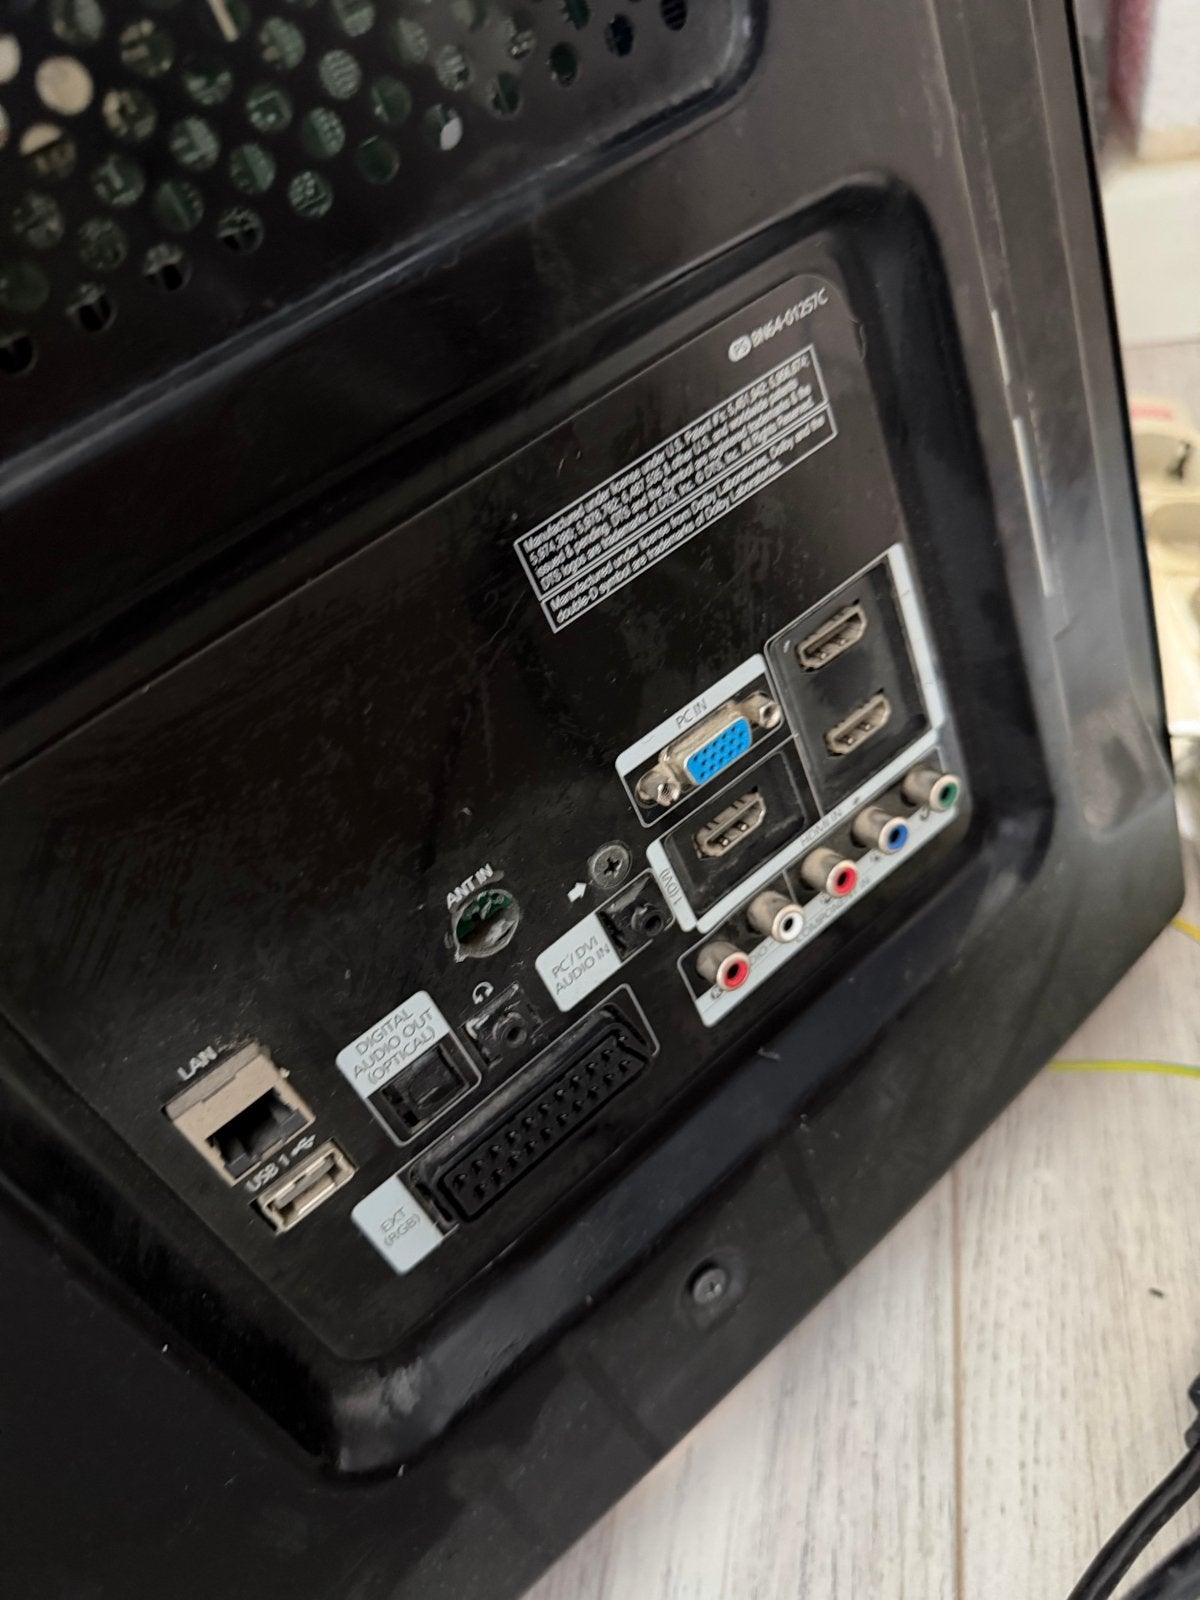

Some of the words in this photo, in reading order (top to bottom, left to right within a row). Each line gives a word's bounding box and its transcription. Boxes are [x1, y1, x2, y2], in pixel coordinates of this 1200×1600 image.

[550, 561, 612, 610] Manufactured
[612, 544, 638, 568] under
[690, 490, 716, 514] Dolby
[769, 436, 793, 459] Dolby
[610, 505, 630, 527] DTS
[630, 493, 648, 513] and
[647, 485, 662, 501] the
[540, 568, 561, 590] DTS
[586, 543, 601, 560] are
[598, 563, 631, 593] symbol
[631, 554, 647, 571] are
[704, 496, 729, 519] Dolby
[675, 708, 694, 729] PC
[693, 697, 708, 716] IN
[446, 875, 476, 910] ANT
[475, 863, 494, 886] IN
[556, 956, 596, 996] AUDIO
[596, 943, 611, 960] IN
[354, 1035, 401, 1080] AUDIO
[402, 1007, 433, 1038] OUT
[355, 1008, 413, 1056] DIGITAL
[368, 1026, 436, 1085] (OPTICAL)
[177, 1045, 218, 1081] LAN
[245, 1162, 279, 1192] USB
[278, 1153, 291, 1167] 1
[381, 1205, 406, 1233] EXT
[384, 1213, 421, 1246] (RGB)
